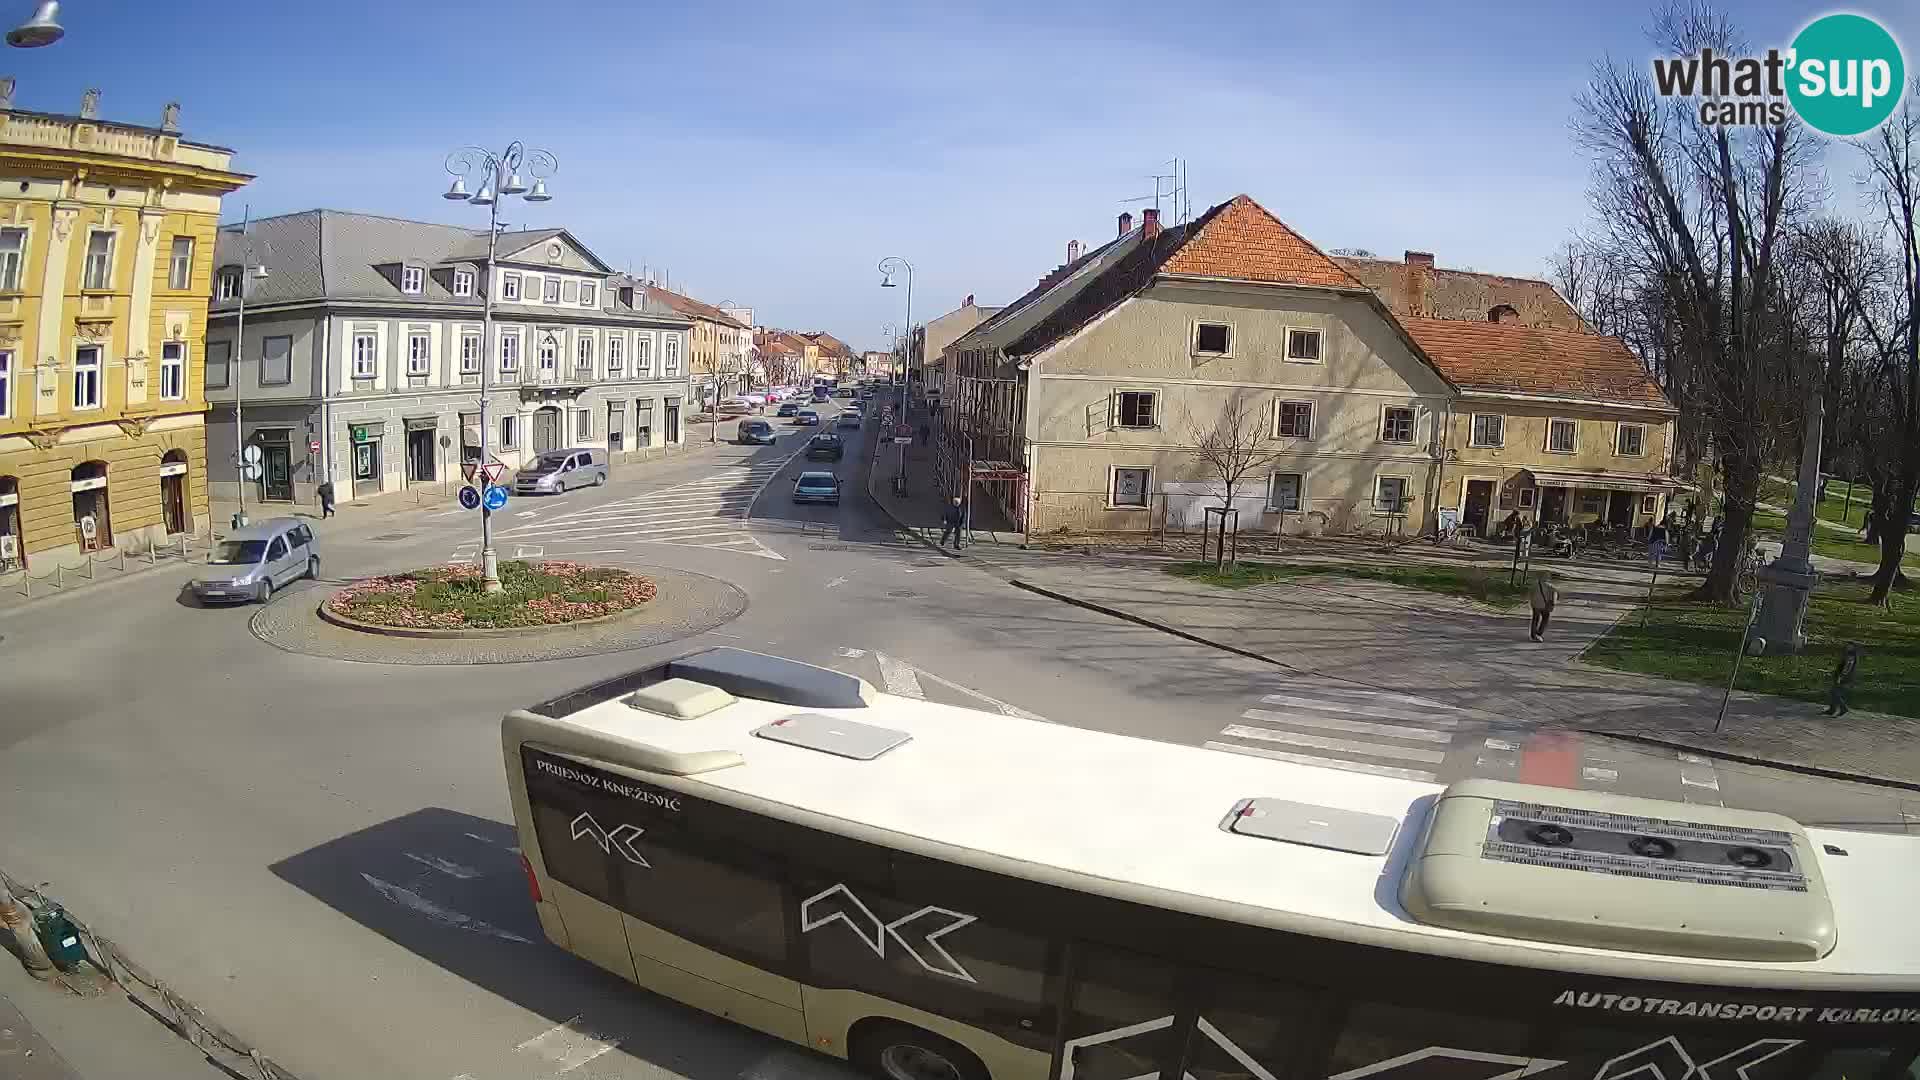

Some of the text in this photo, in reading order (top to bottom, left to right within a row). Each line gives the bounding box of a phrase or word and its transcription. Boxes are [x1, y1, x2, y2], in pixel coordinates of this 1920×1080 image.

[536, 759, 682, 812] PRIJEVOZ KNEŽEVIĆ
[1552, 989, 1813, 1023] AUTOTRANSPORT
